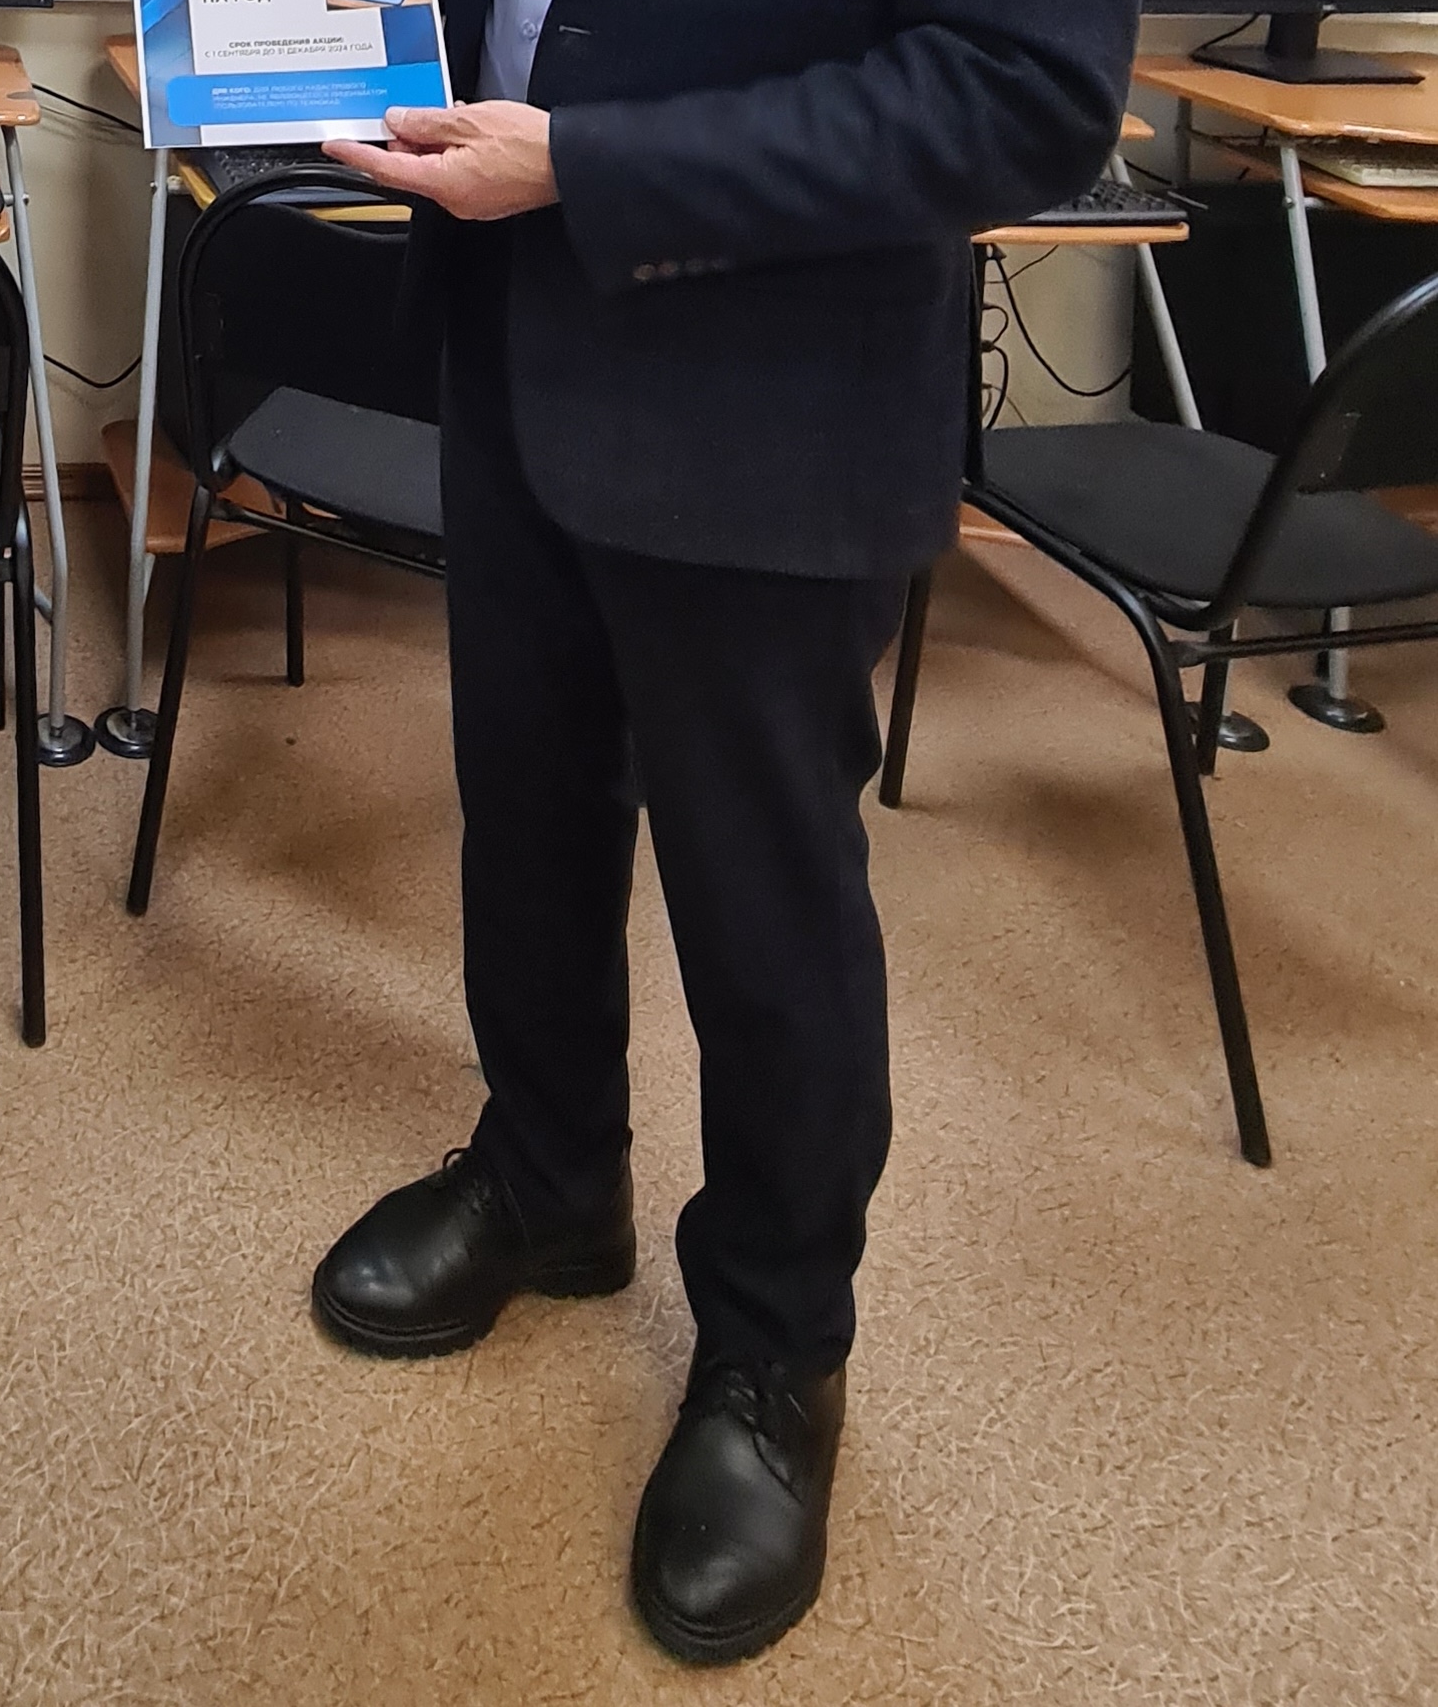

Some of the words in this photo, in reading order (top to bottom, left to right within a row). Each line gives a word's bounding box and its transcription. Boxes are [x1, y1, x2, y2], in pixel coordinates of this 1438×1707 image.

[228, 41, 252, 49] СРОК
[254, 37, 311, 47] ПРОВЕДЕНИЯ
[350, 42, 373, 51] ГОДА
